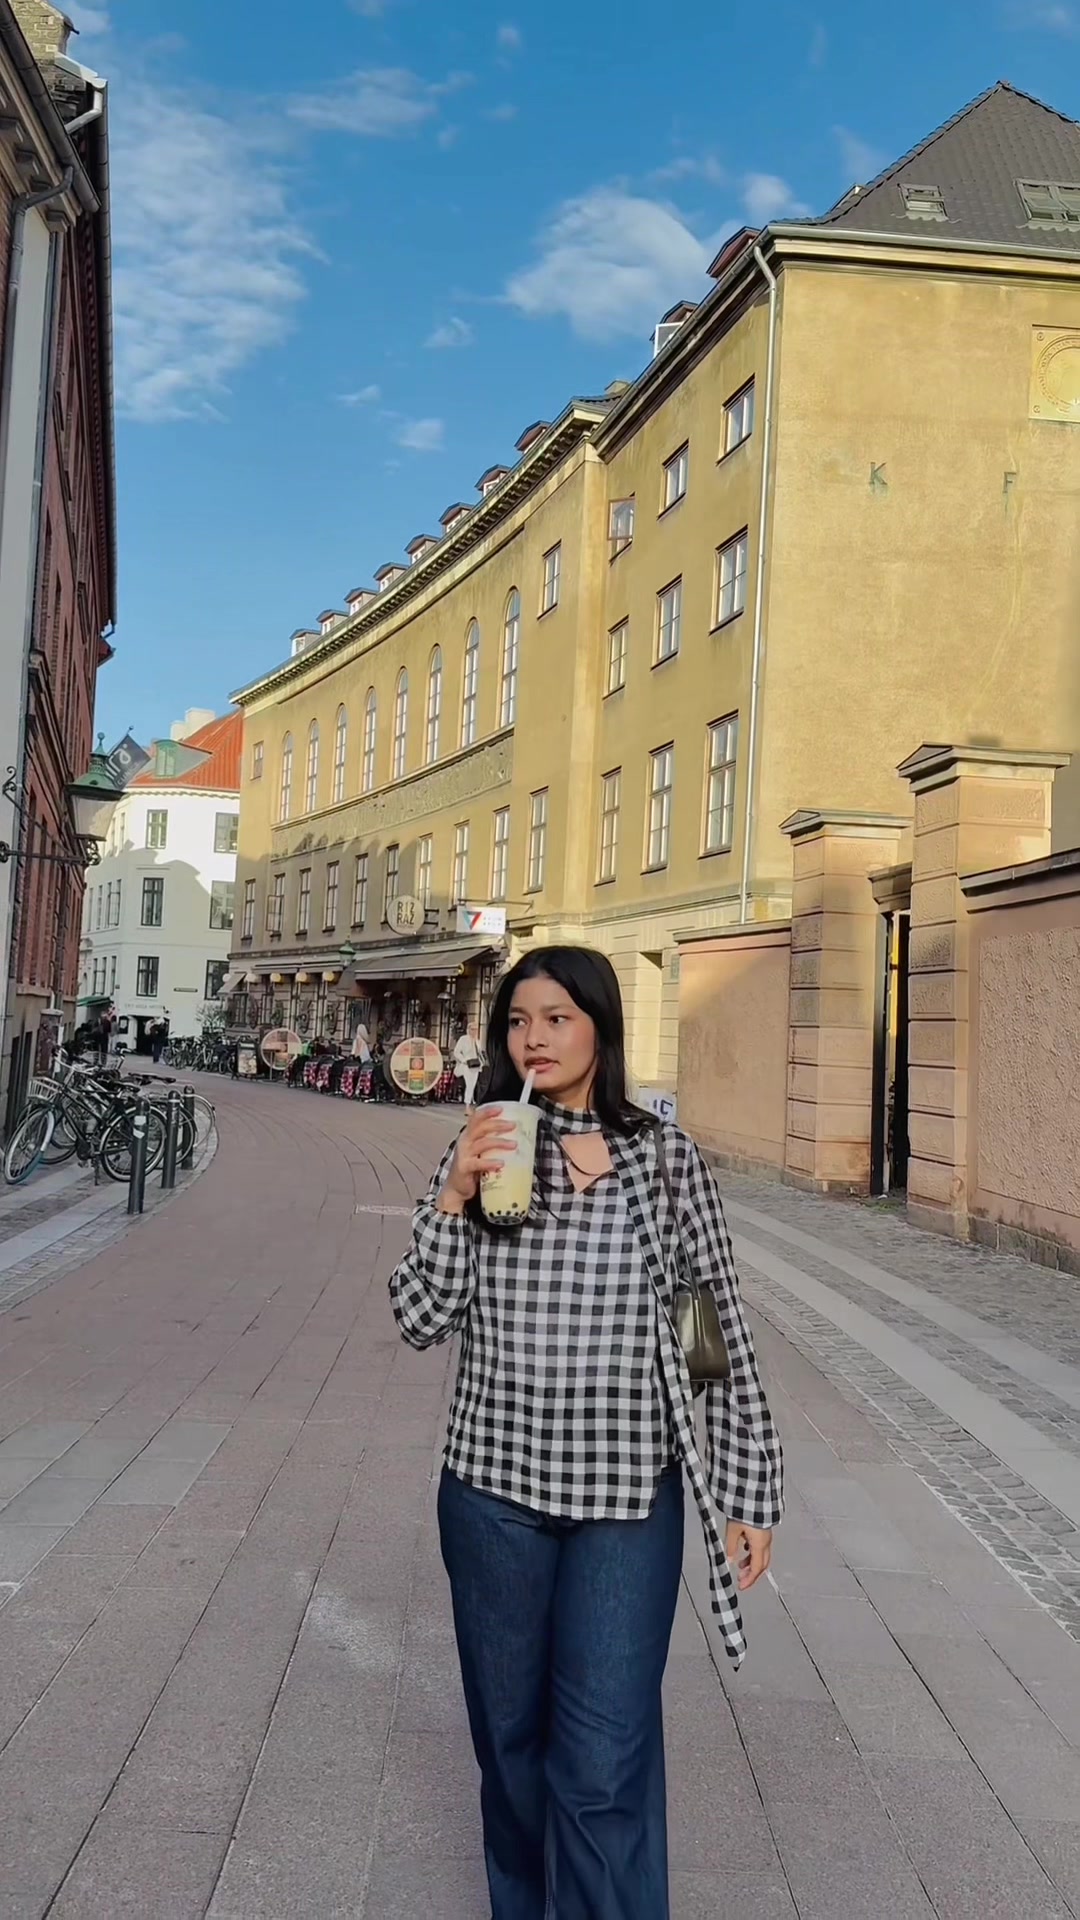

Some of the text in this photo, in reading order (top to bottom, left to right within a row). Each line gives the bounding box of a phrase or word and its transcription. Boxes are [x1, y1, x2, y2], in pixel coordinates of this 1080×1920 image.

[869, 461, 1017, 494] K F
[397, 901, 415, 913] RIZ
[397, 912, 415, 925] RAZ
